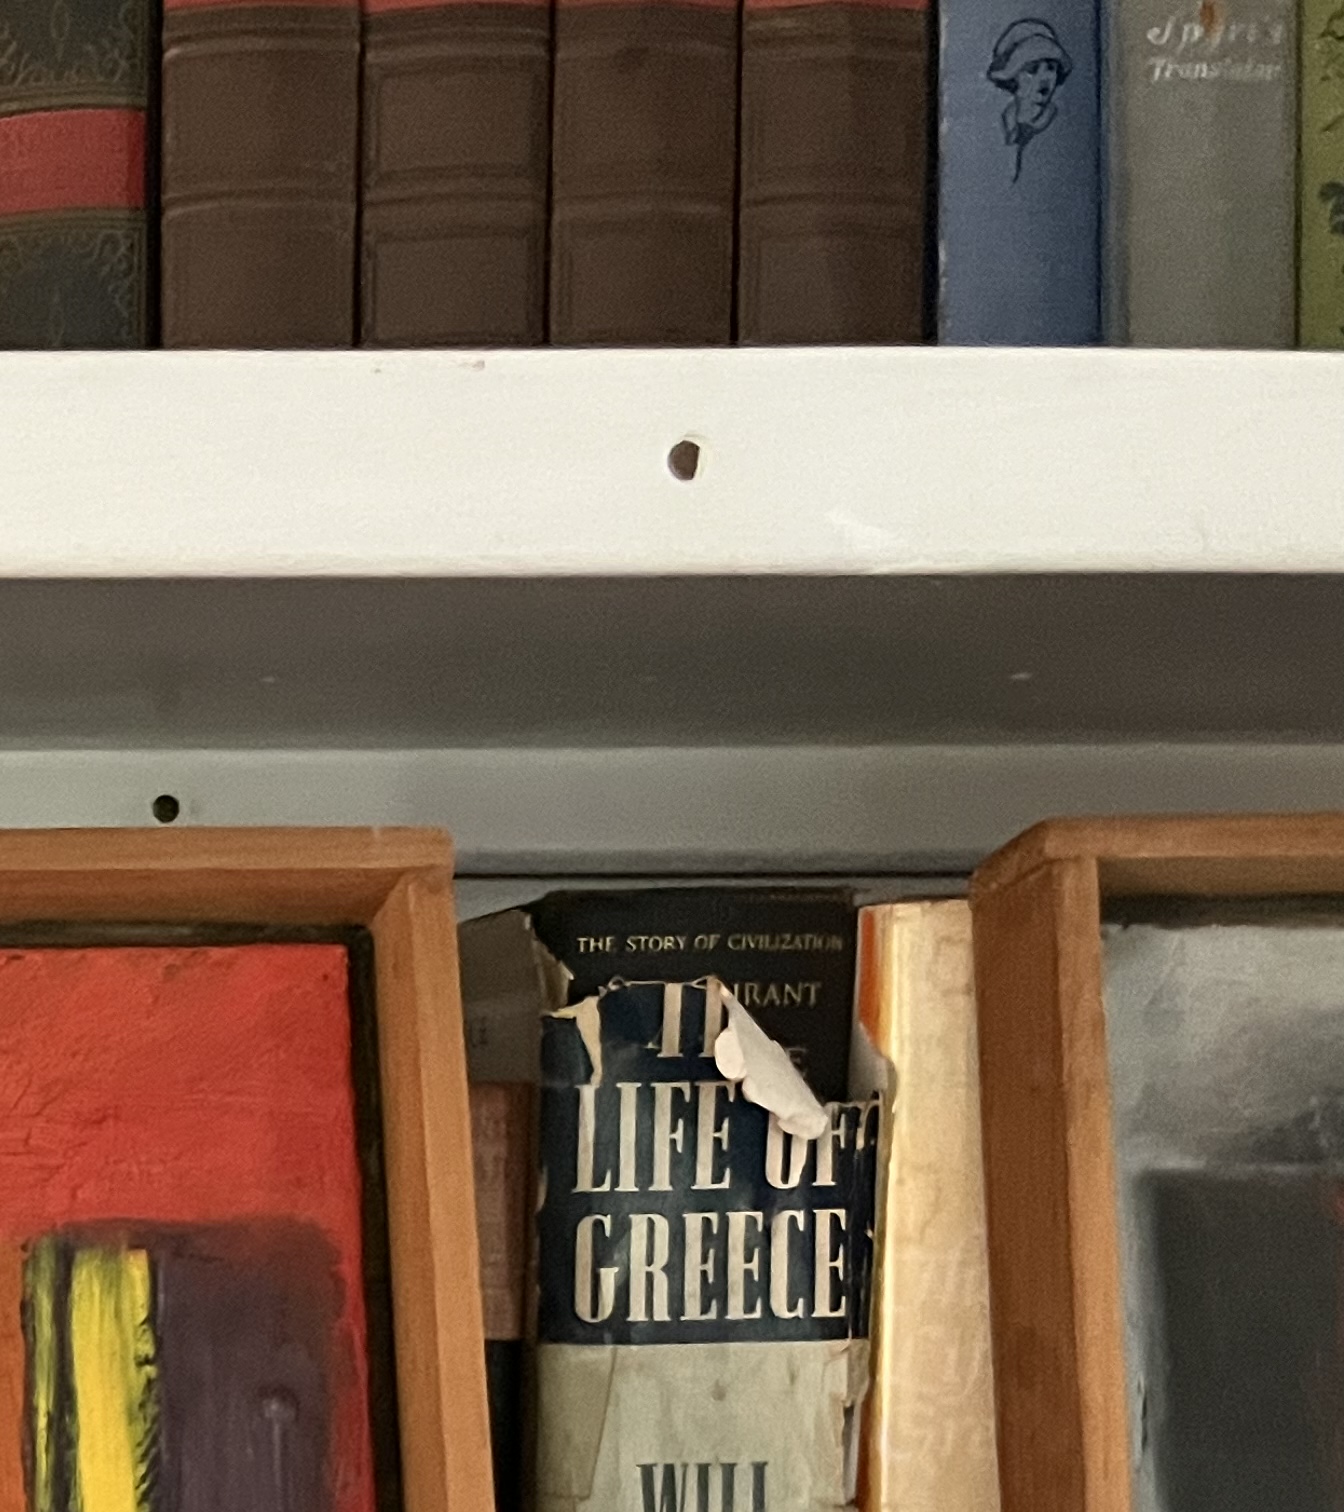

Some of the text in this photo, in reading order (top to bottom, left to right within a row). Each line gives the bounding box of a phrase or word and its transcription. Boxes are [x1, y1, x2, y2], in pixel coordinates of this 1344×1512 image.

[577, 932, 844, 953] THE STORY OF CIVILIZATION
[571, 1081, 736, 1193] LIFE
[765, 1102, 848, 1190] OF
[574, 1209, 847, 1323] GREECE
